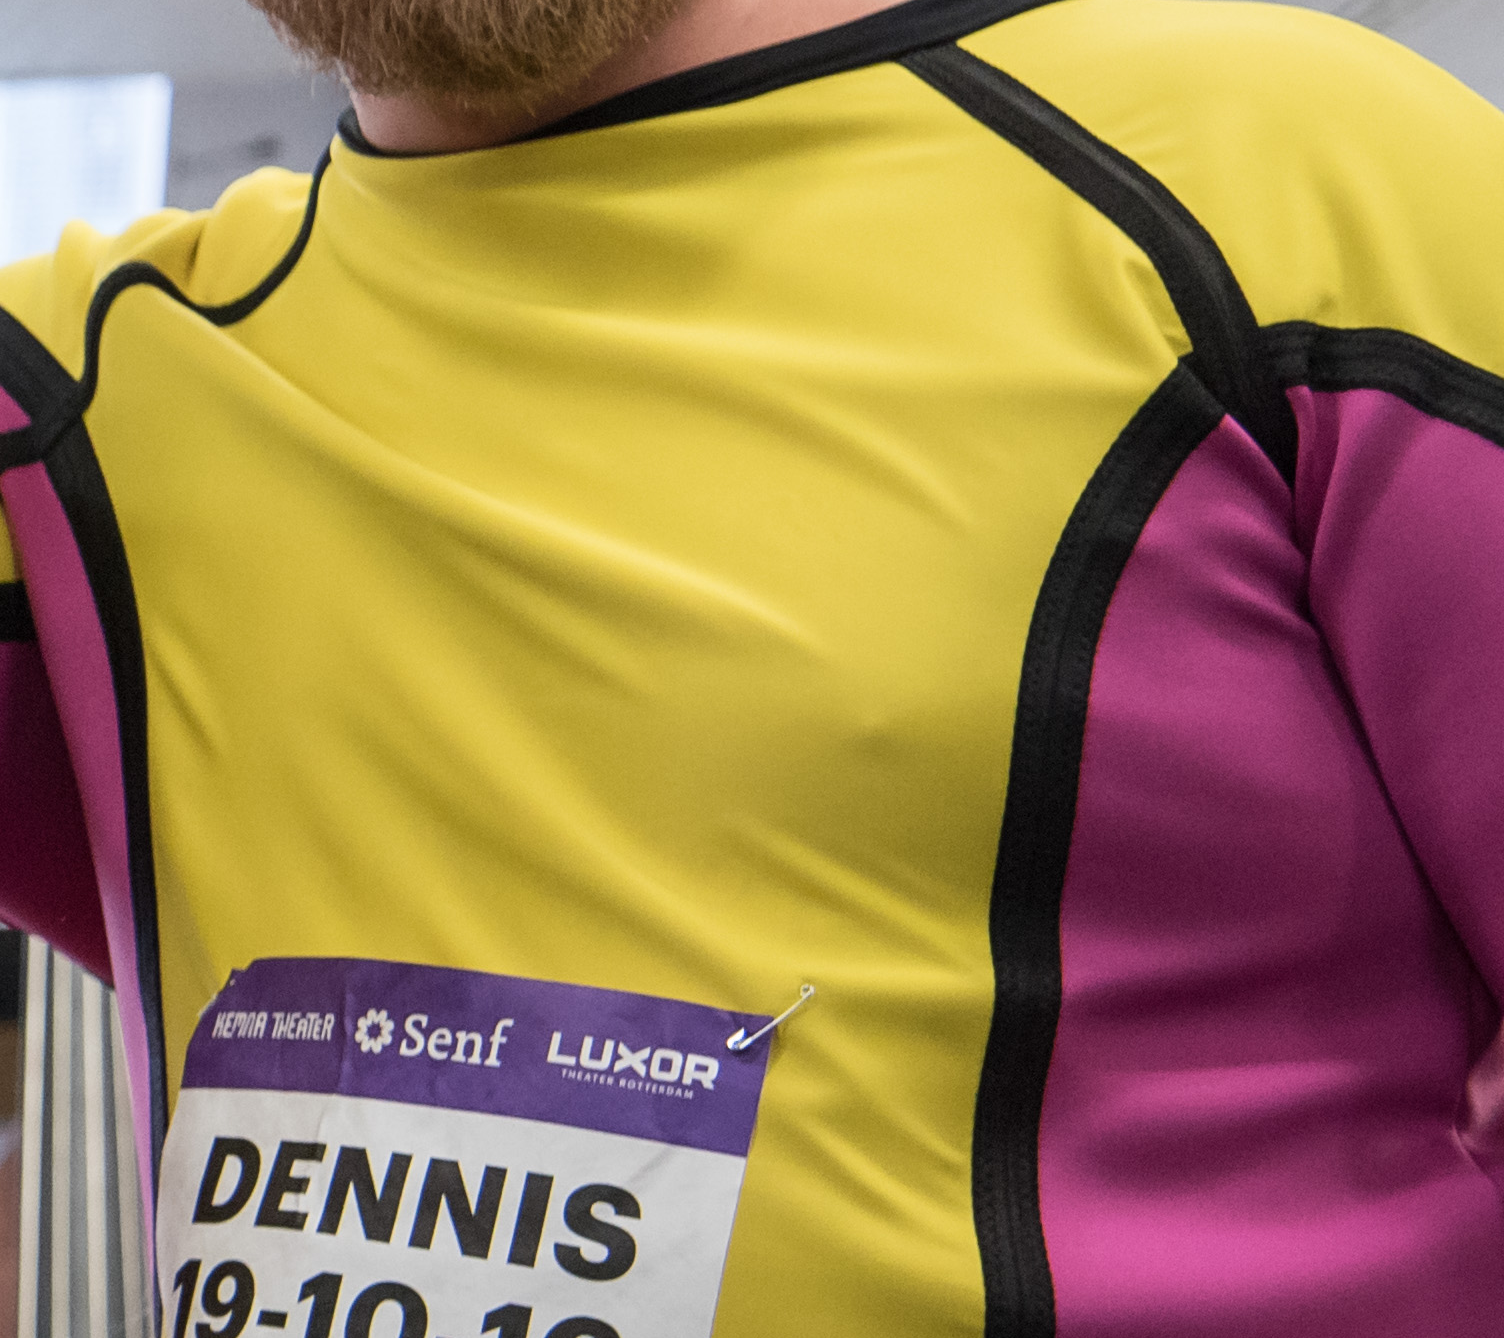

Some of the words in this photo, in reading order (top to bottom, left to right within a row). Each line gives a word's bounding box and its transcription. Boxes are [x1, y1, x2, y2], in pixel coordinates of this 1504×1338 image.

[271, 1011, 335, 1041] THEATER
[399, 1014, 514, 1068] Senf
[547, 1031, 720, 1090] LUXOR
[561, 1068, 614, 1086] THEATER
[619, 1078, 694, 1100] ROTTERDAM
[192, 1137, 642, 1281] DENNIS
